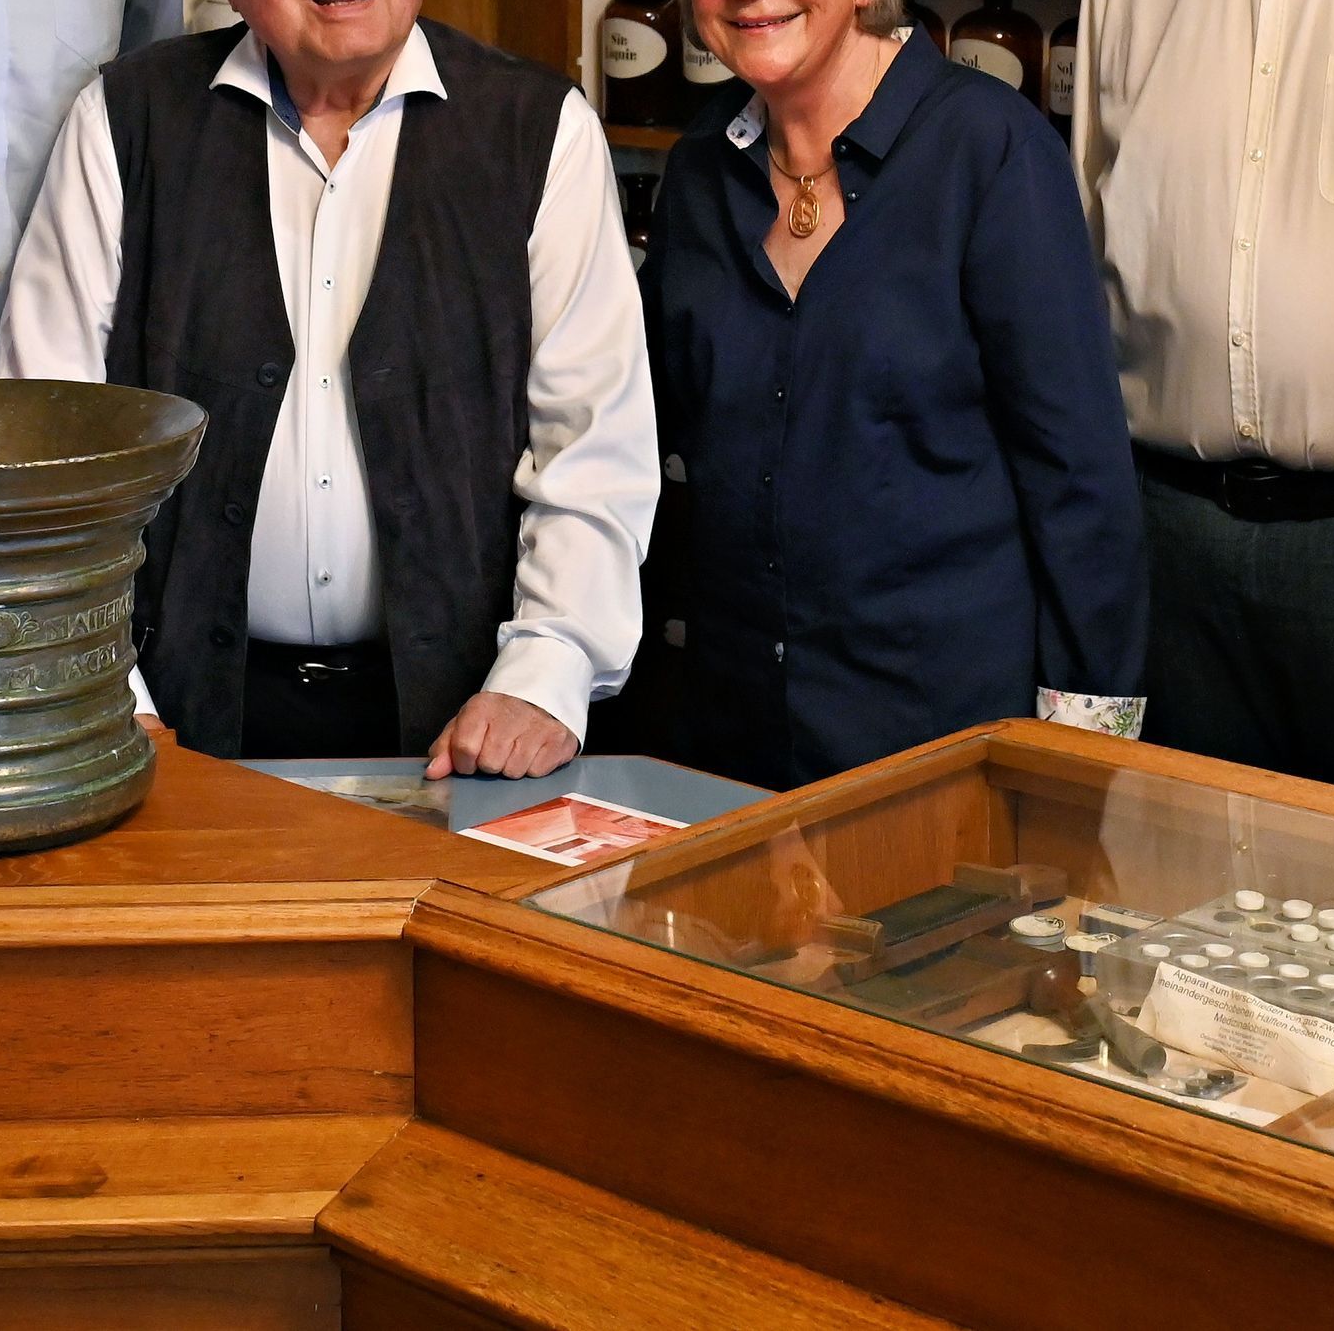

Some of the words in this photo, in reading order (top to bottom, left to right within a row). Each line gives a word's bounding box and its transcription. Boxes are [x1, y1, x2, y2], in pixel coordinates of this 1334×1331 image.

[1172, 969, 1209, 990] Apparat
[1209, 984, 1231, 998] zum
[1302, 1016, 1319, 1028] aus
